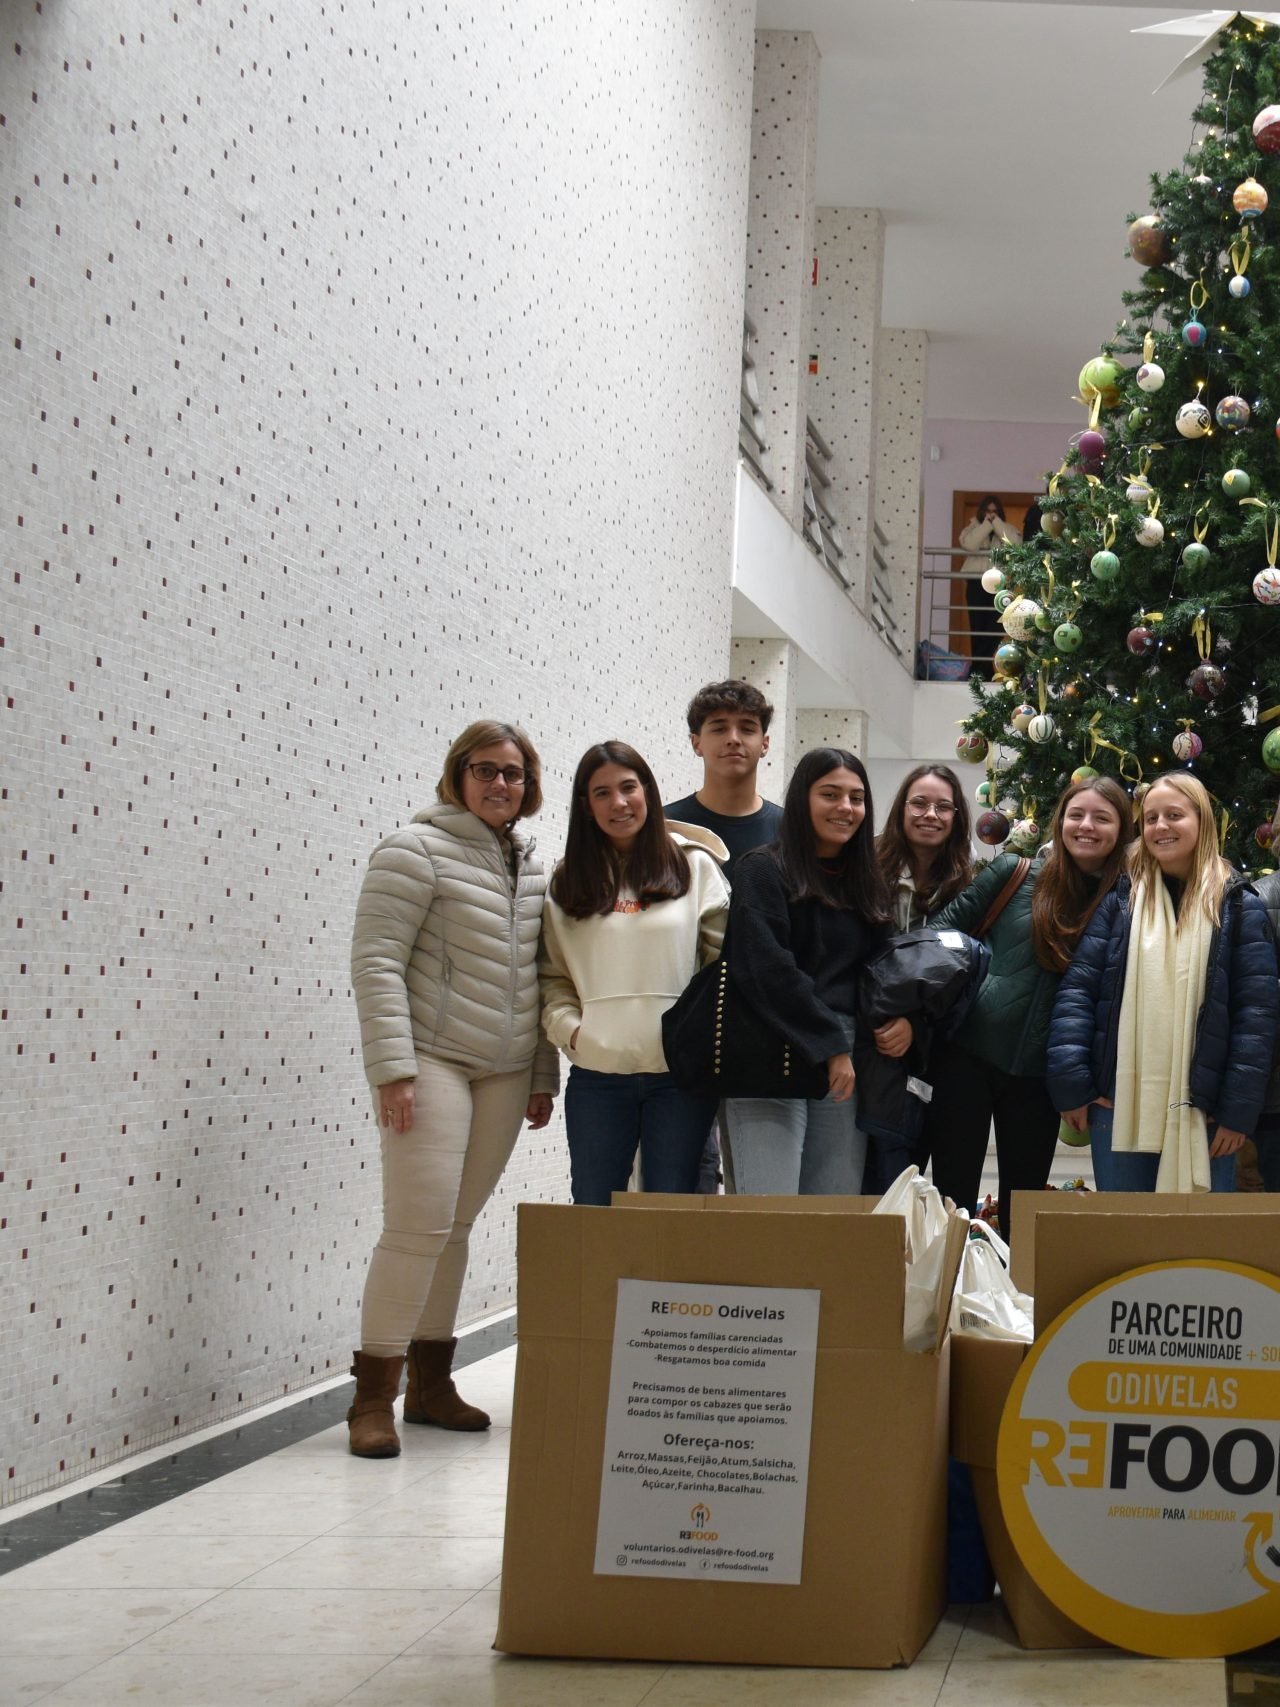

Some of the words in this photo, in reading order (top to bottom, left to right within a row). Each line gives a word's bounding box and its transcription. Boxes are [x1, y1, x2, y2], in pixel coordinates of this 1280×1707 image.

[651, 1301, 713, 1317] REFOOD
[718, 1305, 785, 1320] Odivelas
[1109, 1300, 1243, 1340] PARCEIRO
[641, 1328, 687, 1340] -Apoiamos
[728, 1334, 783, 1343] carenciadas
[626, 1339, 687, 1351] -Combatemos
[696, 1344, 749, 1356] desperdício
[751, 1347, 797, 1357] alimentar
[1108, 1338, 1125, 1355] DE
[1128, 1340, 1156, 1357] UMA
[1160, 1341, 1242, 1361] COMUNIDADE
[654, 1354, 711, 1365] -Resgatamos
[713, 1357, 731, 1366] boa
[732, 1358, 766, 1367] comida
[633, 1381, 686, 1393] Precisamos
[688, 1385, 700, 1394] de
[702, 1386, 726, 1396] bens
[727, 1387, 786, 1398] alimentares
[1105, 1371, 1239, 1410] ODIVELAS
[627, 1395, 650, 1405] para
[651, 1397, 688, 1408] compor
[690, 1400, 701, 1408] os
[703, 1399, 742, 1410] cabazes
[744, 1403, 763, 1413] que
[764, 1402, 792, 1412] serão
[627, 1407, 661, 1418] doados
[663, 1410, 674, 1419] às
[717, 1414, 736, 1424] que
[737, 1415, 788, 1425] apoiamos.
[663, 1433, 755, 1450] Ofereça-nos:
[1107, 1505, 1161, 1520] APROVEITAR
[1162, 1507, 1186, 1521] PARA
[1187, 1508, 1237, 1522] ALIMENTAR
[623, 1543, 774, 1561] voluntarios.odivelas@re-food.org
